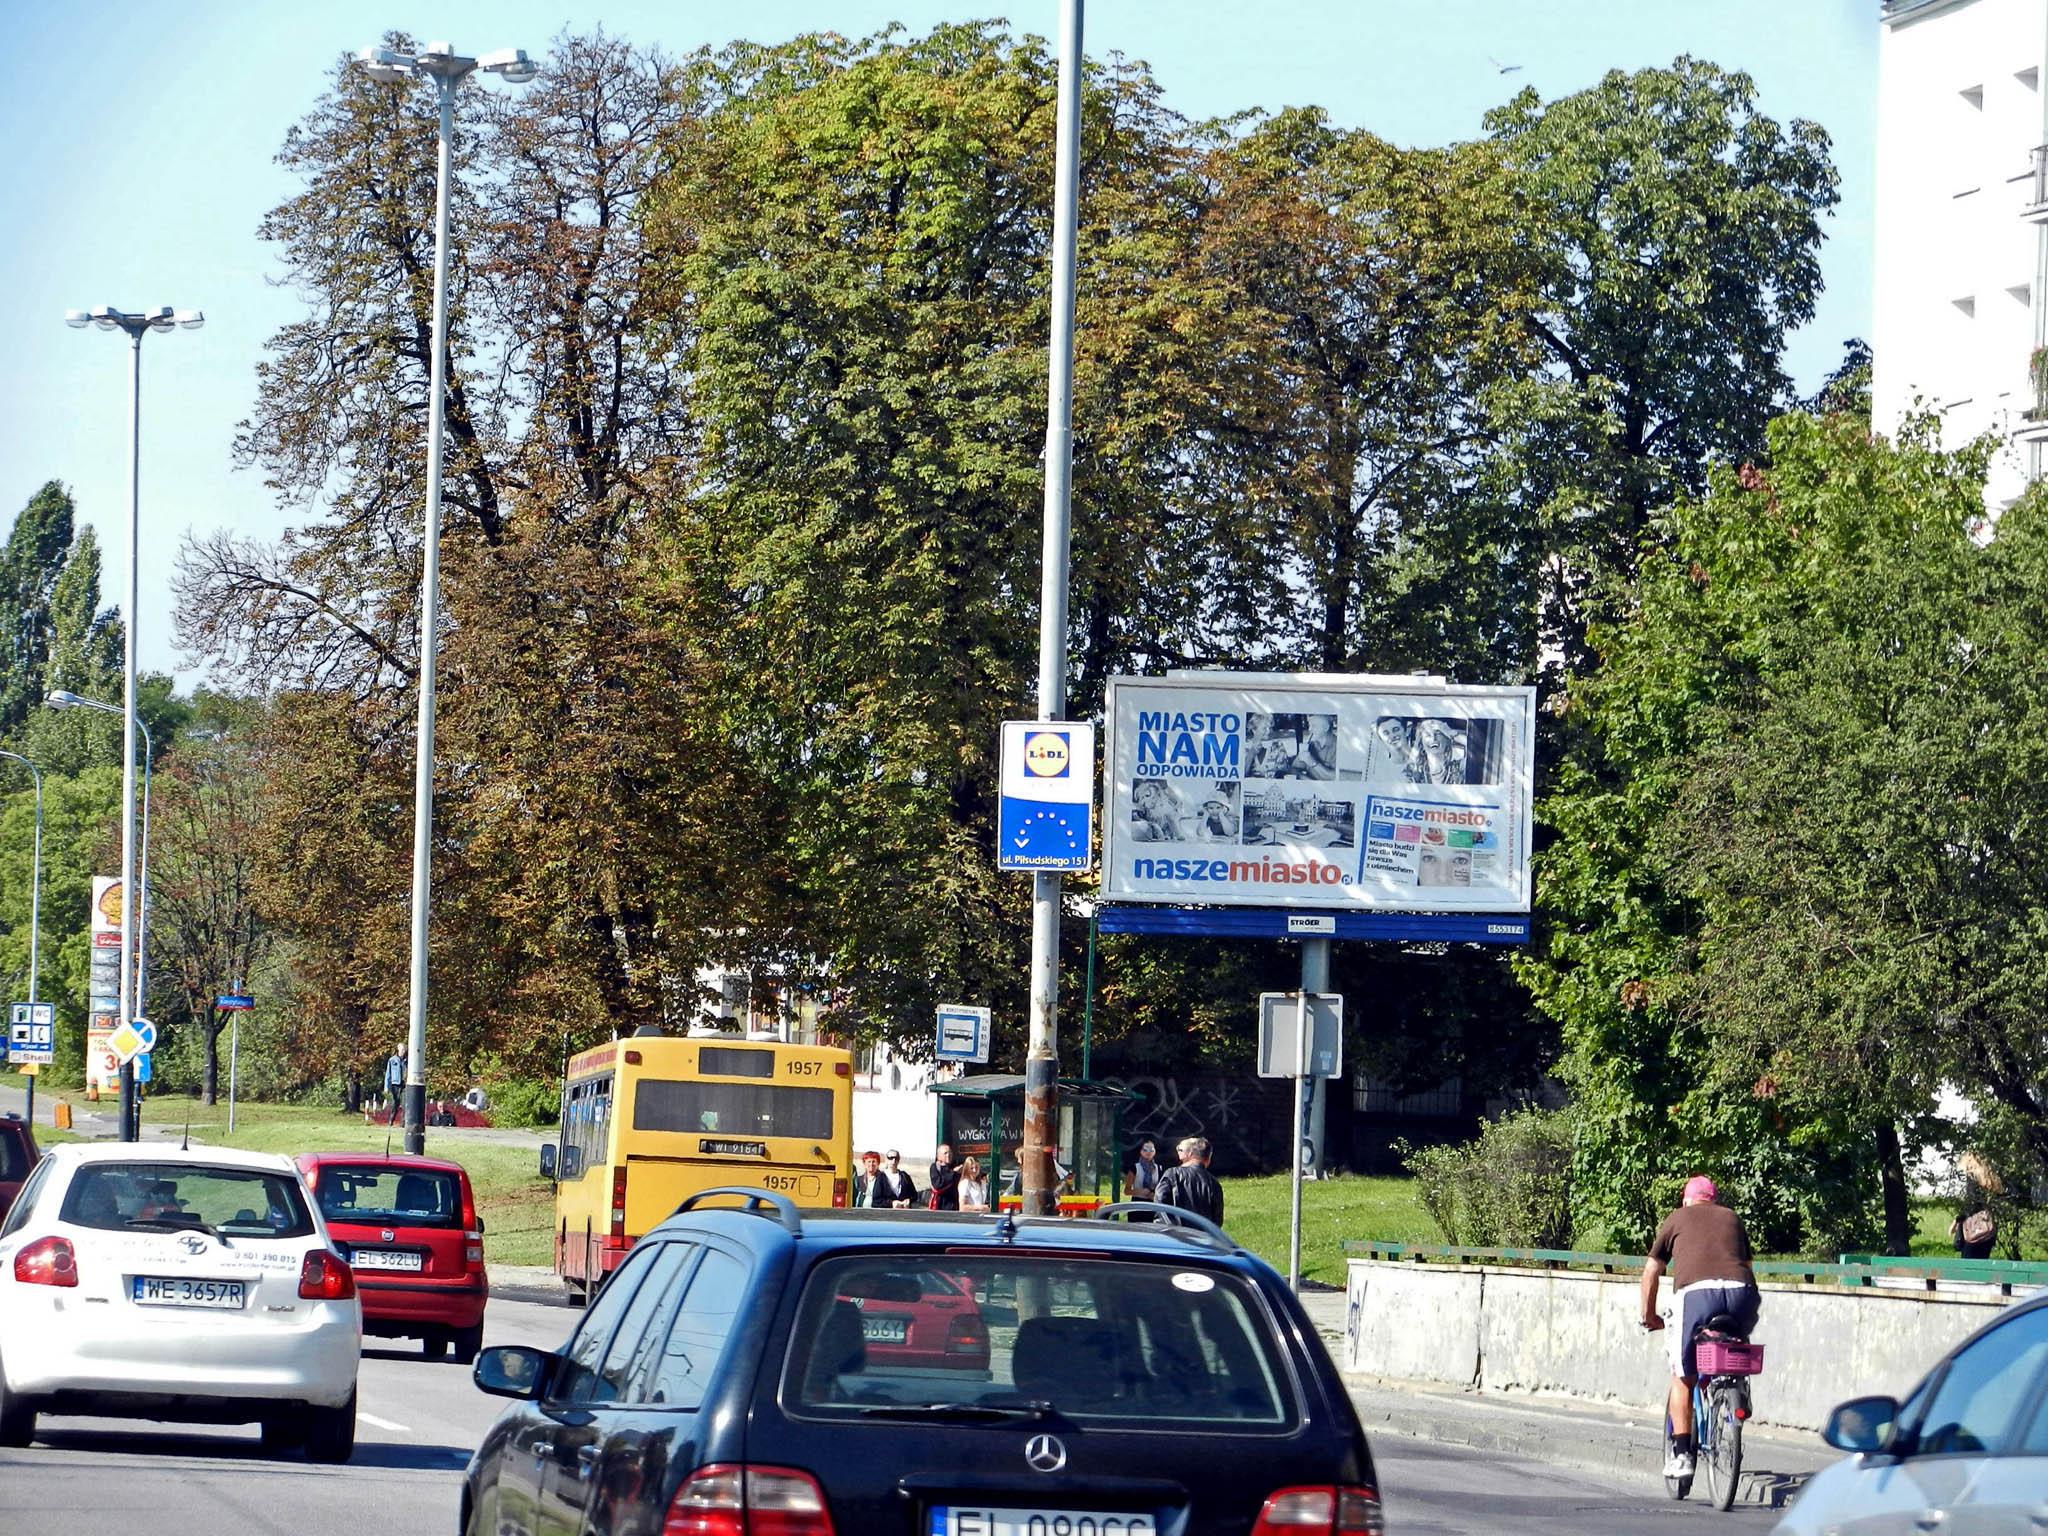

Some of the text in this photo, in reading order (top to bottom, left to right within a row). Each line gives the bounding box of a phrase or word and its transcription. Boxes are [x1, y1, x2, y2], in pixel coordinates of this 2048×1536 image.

[1139, 712, 1240, 733] MIASTO
[1138, 732, 1239, 765] NAM
[1136, 764, 1239, 778] ODPOWIADA
[1072, 857, 1086, 865] 151
[1134, 855, 1342, 885] naszemiasto
[35, 1009, 49, 1017] WC
[23, 1053, 51, 1061] Shell
[786, 1062, 823, 1076] 1957
[762, 1175, 797, 1190] 1957
[358, 1251, 420, 1266] EL 562LU
[148, 1280, 241, 1303] WE 3657R
